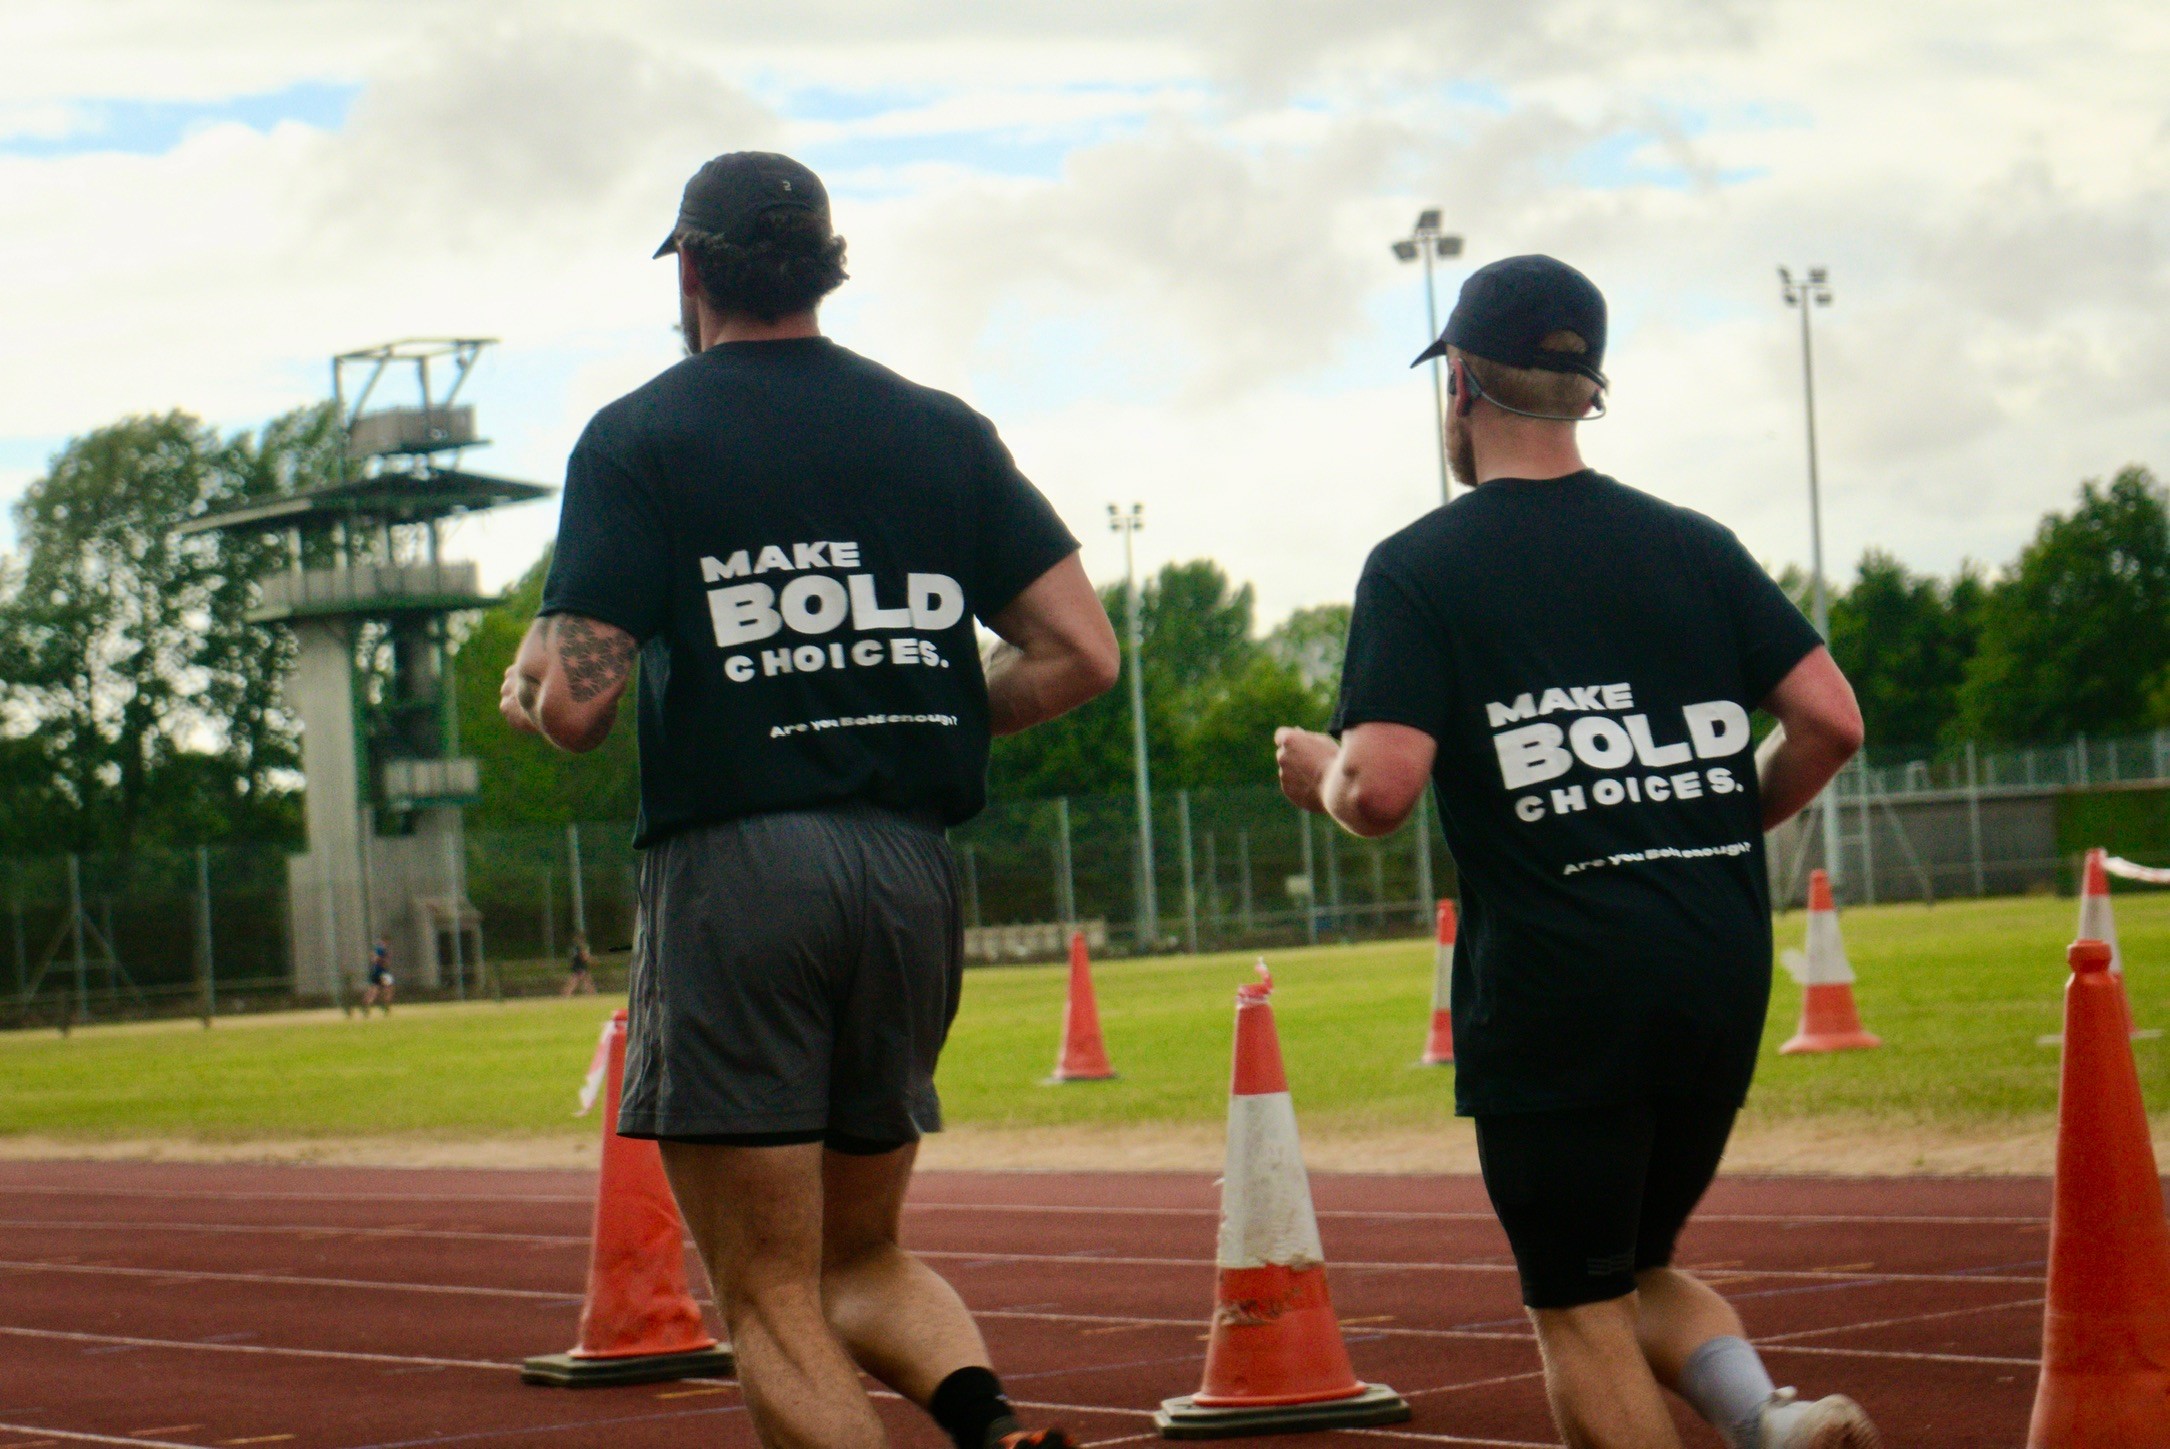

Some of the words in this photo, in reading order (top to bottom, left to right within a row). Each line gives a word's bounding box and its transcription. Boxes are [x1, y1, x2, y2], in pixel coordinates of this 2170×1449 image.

[700, 541, 860, 583] MAKE
[707, 572, 965, 648] BOLD
[724, 638, 949, 683] CHOICES.
[1485, 682, 1634, 728] MAKE
[1493, 700, 1751, 790] BOLD
[1515, 767, 1744, 823] CHOICES.
